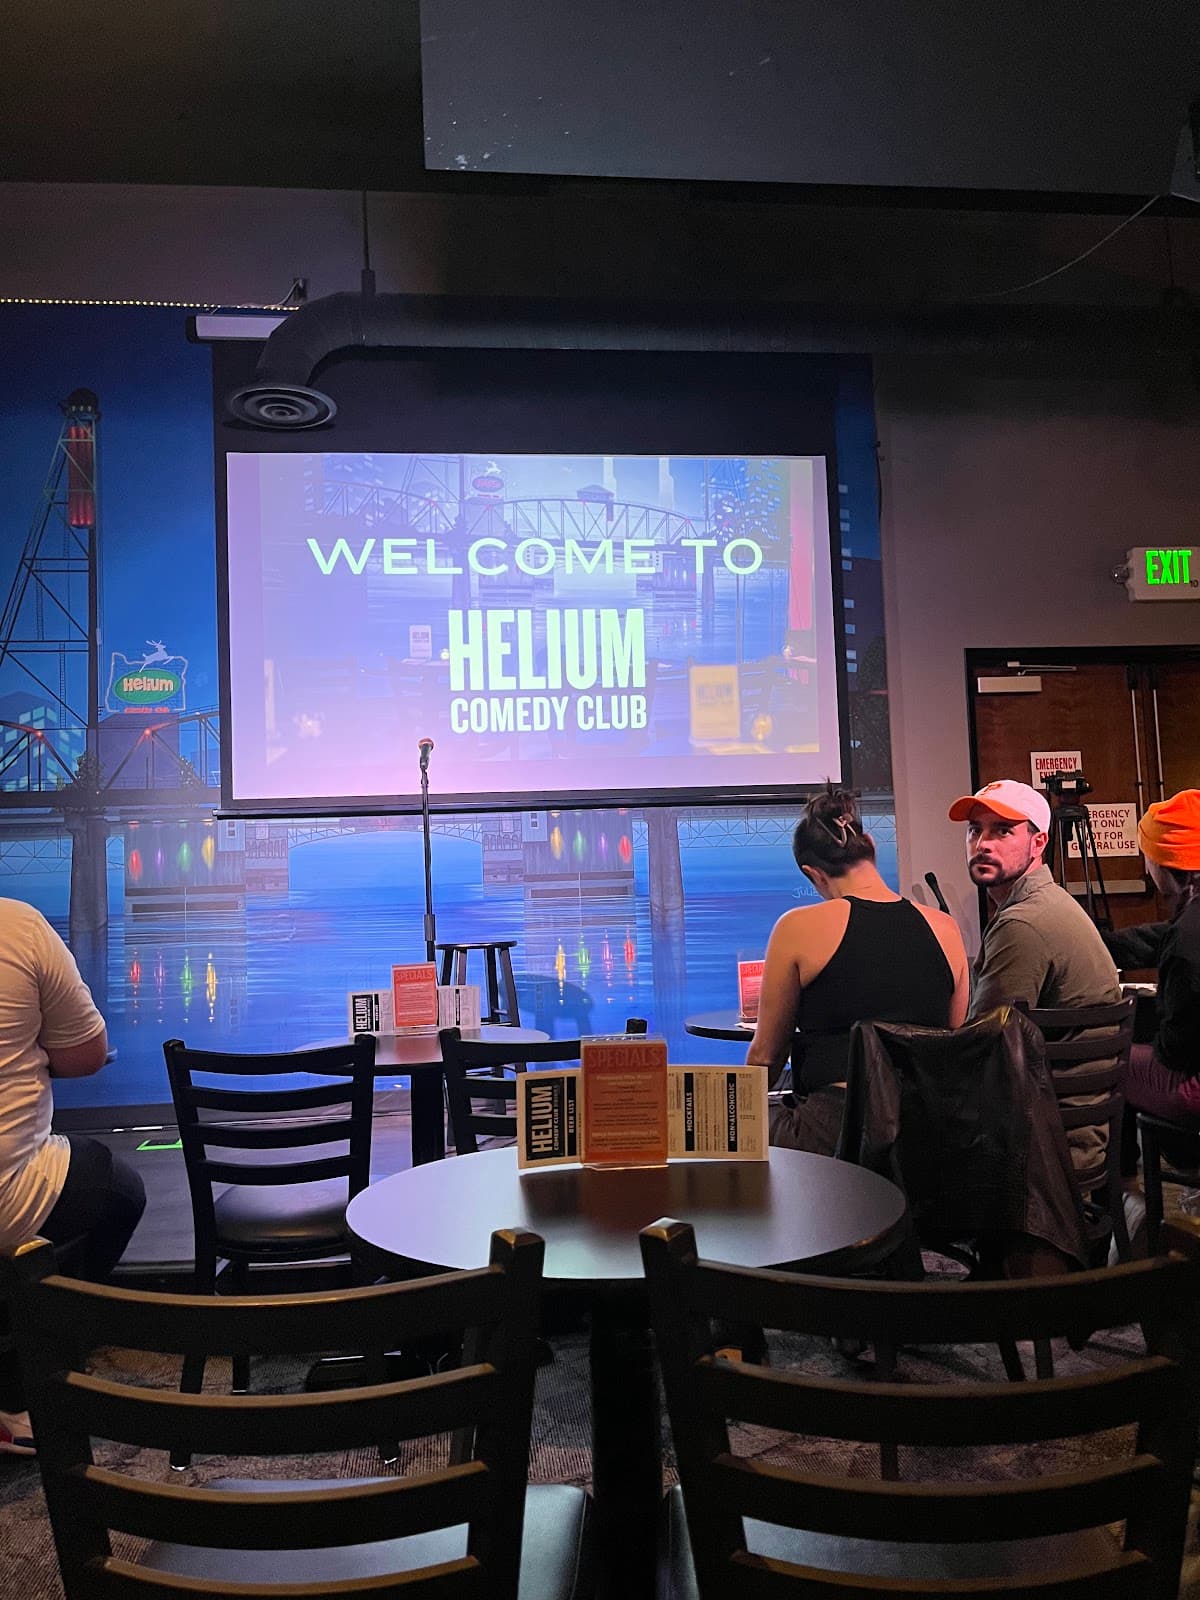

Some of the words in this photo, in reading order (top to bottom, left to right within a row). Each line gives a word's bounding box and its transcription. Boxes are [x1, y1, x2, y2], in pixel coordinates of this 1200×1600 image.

[306, 538, 656, 575] WELCOME
[681, 538, 763, 575] TO
[1145, 550, 1192, 585] EXIT
[448, 608, 646, 691] HELIUM
[451, 697, 569, 734] COMEDY
[576, 695, 647, 730] CLUB
[1036, 758, 1077, 770] EMERGENCY
[1087, 809, 1130, 819] ERGENCY
[1101, 819, 1126, 828] ONLY
[1104, 831, 1123, 840] FOR
[1117, 840, 1136, 849] USE
[395, 969, 432, 981] SPECIALS
[355, 998, 368, 1030] HELIUM
[589, 1047, 662, 1068] SPECIALS
[531, 1085, 553, 1153] HELIUM
